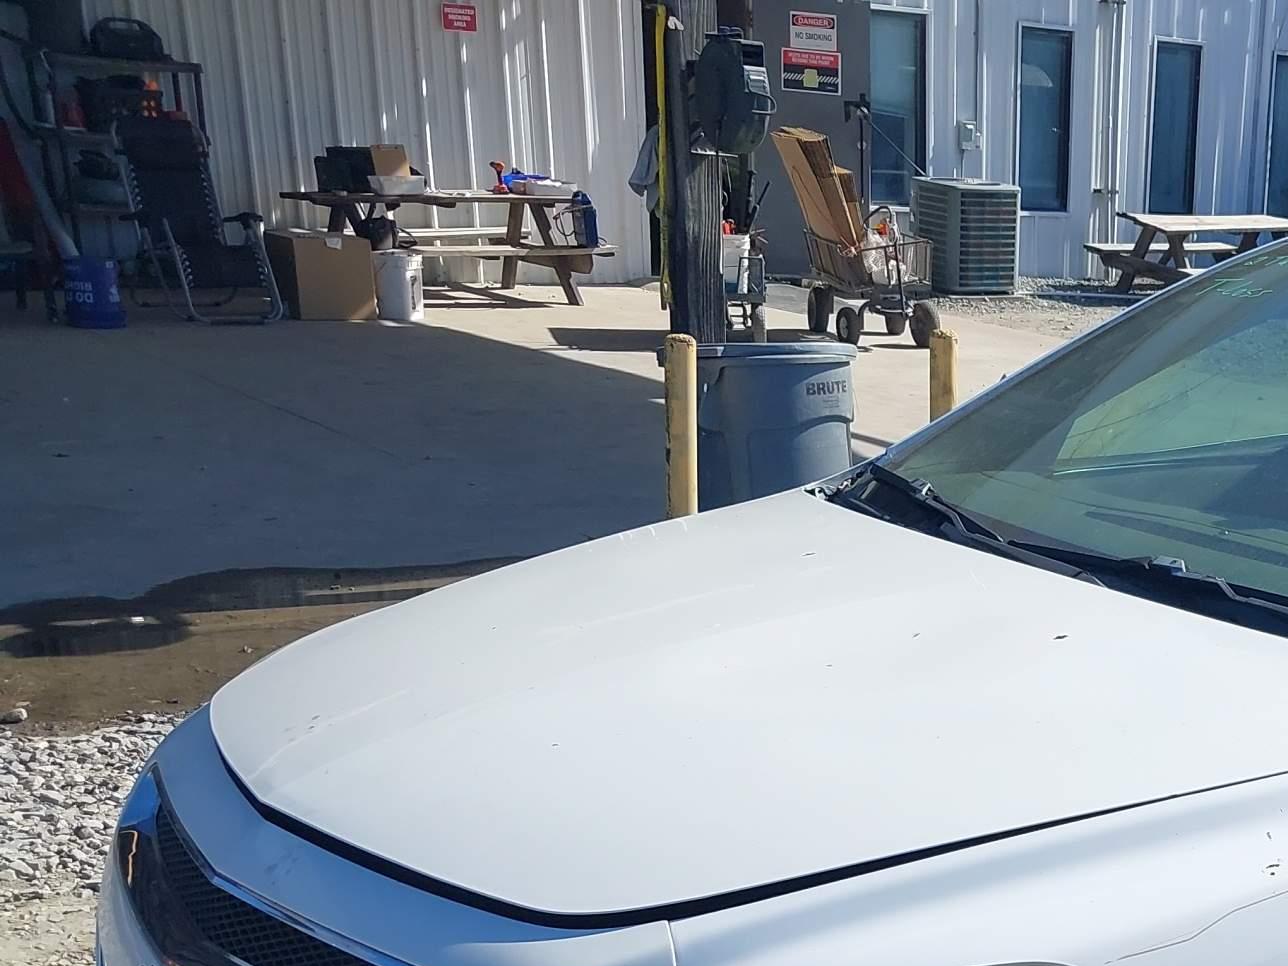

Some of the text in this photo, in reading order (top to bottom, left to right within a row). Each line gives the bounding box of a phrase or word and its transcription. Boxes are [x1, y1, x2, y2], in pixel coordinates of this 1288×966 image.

[798, 17, 829, 26] DANGER
[795, 31, 832, 41] NO SMOKING
[806, 380, 847, 396] BRUTE
